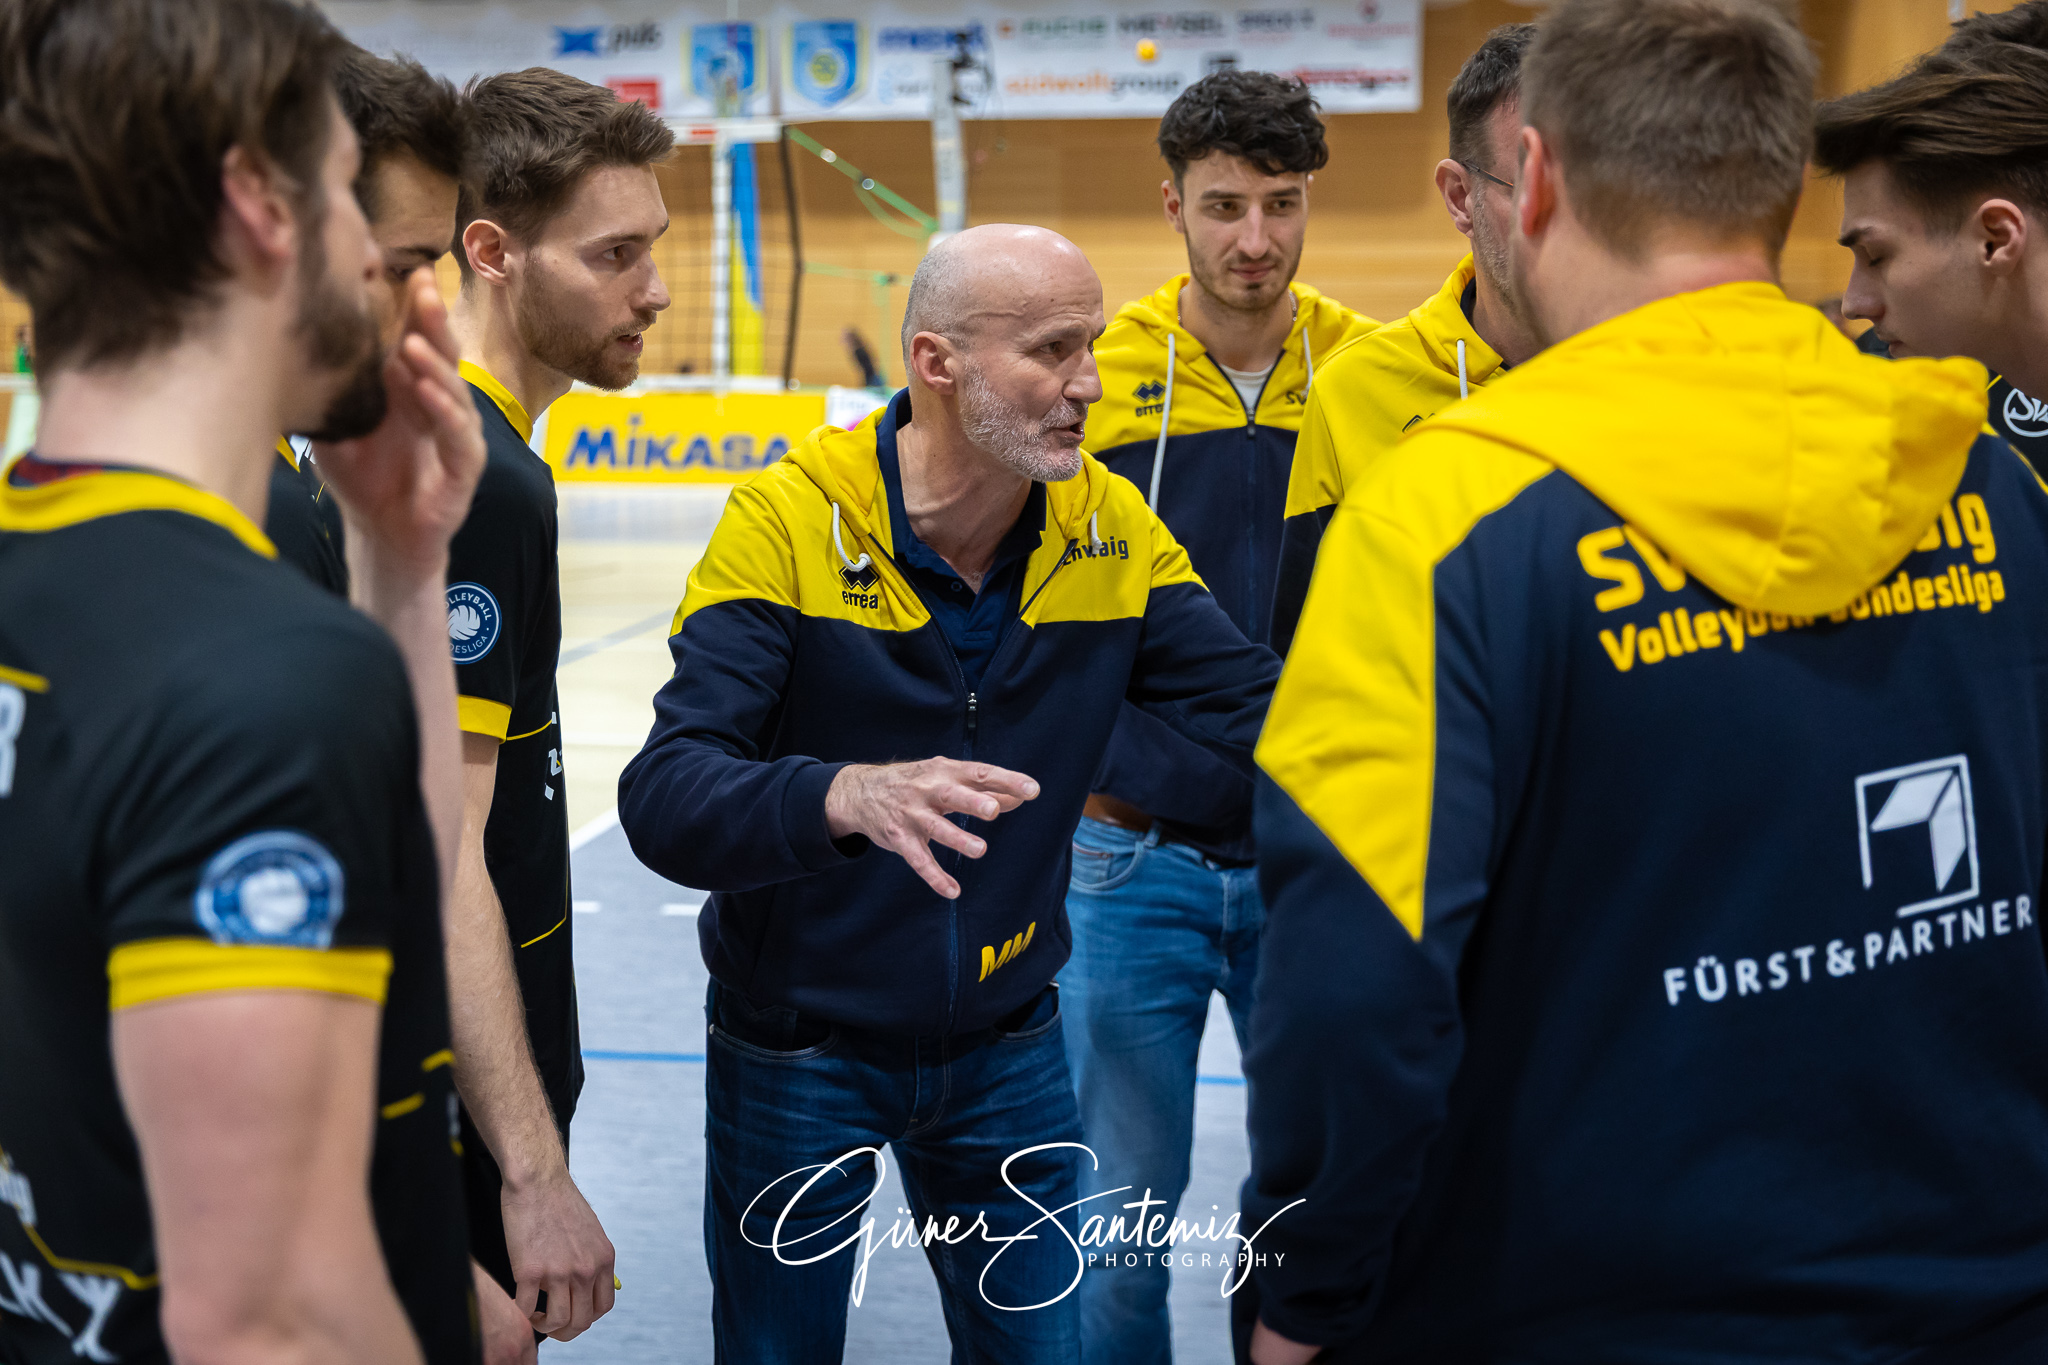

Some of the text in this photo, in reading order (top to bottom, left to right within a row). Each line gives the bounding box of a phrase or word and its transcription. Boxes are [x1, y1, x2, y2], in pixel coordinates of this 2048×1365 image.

[1063, 536, 1129, 565] hwaig
[842, 589, 879, 610] errea
[1829, 563, 2006, 624] undesliga
